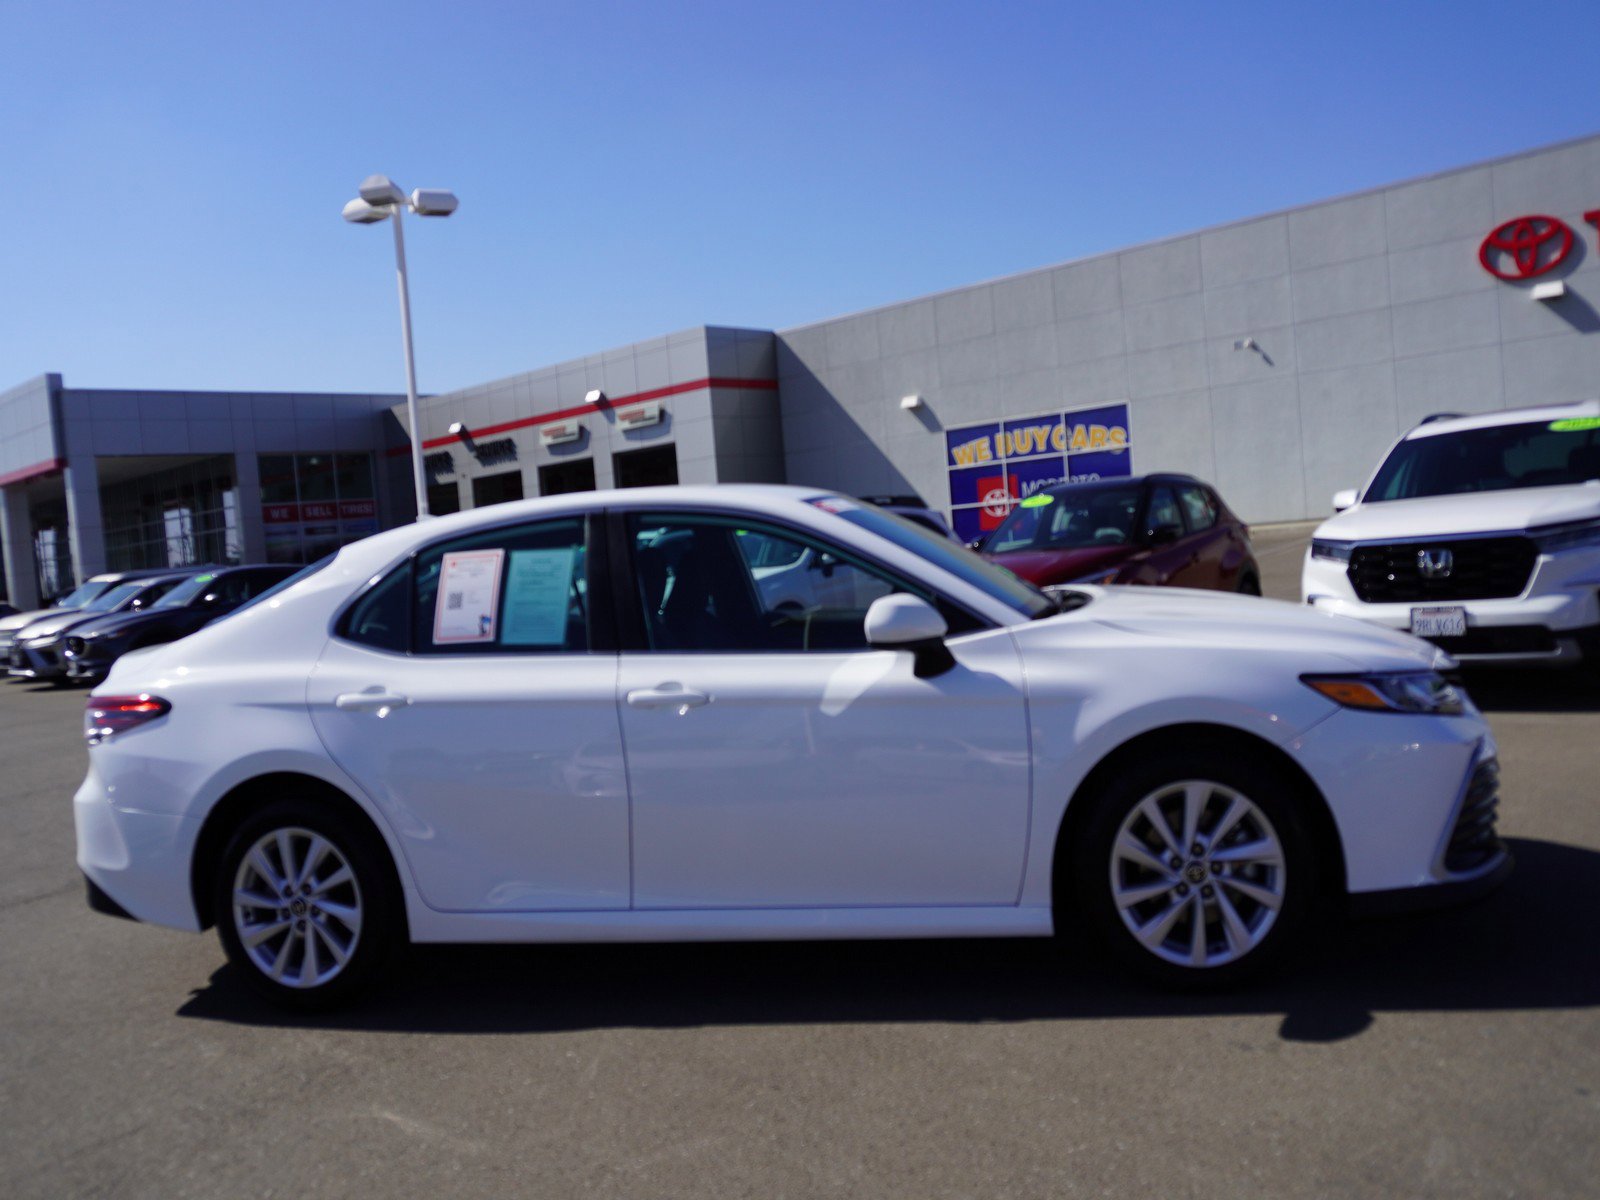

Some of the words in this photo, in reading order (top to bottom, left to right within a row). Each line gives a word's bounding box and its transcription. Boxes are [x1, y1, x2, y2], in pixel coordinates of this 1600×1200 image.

[952, 436, 992, 467] WE
[995, 425, 1052, 458] BUY
[1051, 425, 1127, 454] CARS
[270, 508, 289, 519] WE
[304, 506, 333, 517] SELL
